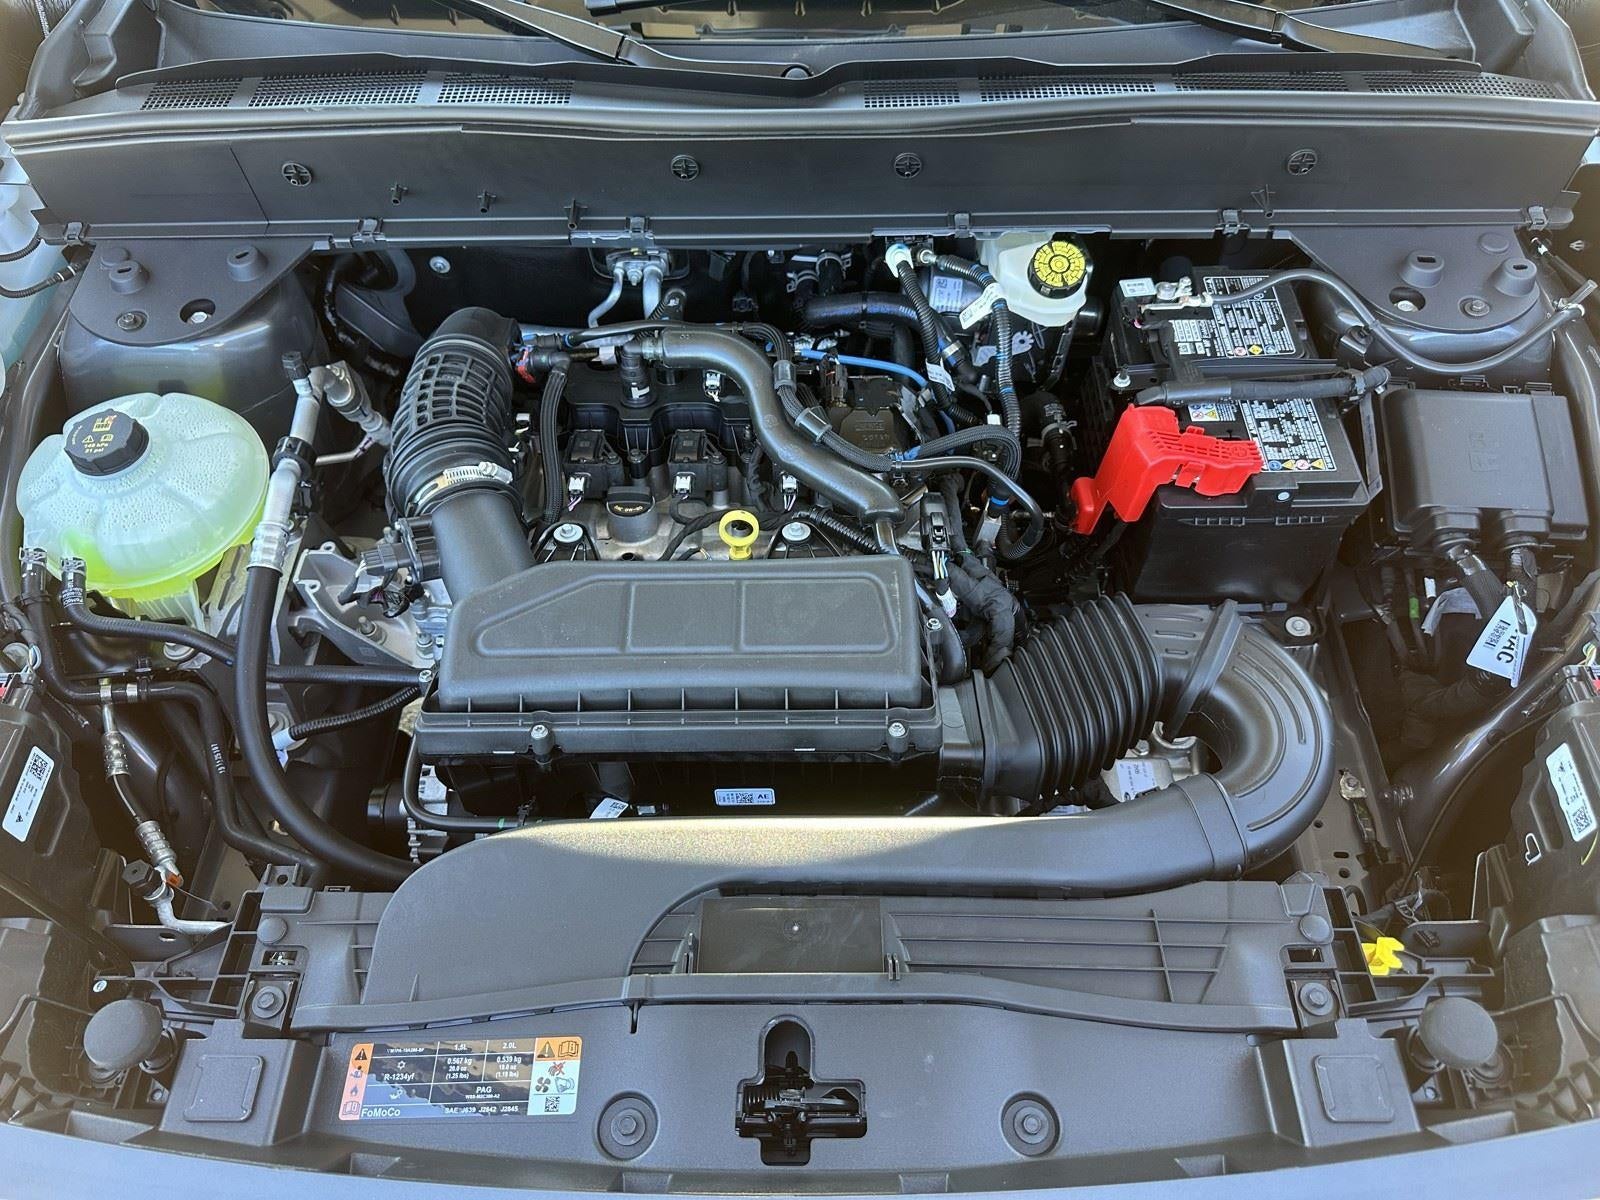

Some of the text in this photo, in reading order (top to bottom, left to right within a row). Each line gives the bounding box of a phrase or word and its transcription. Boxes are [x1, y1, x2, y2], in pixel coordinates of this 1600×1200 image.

[502, 1041, 517, 1049] 2.0L
[446, 1057, 473, 1066] 0.567 kg
[513, 1056, 522, 1064] kg
[383, 1072, 416, 1082] R-1234yf
[475, 1086, 493, 1094] PAG
[360, 1107, 401, 1118] FoMoCo
